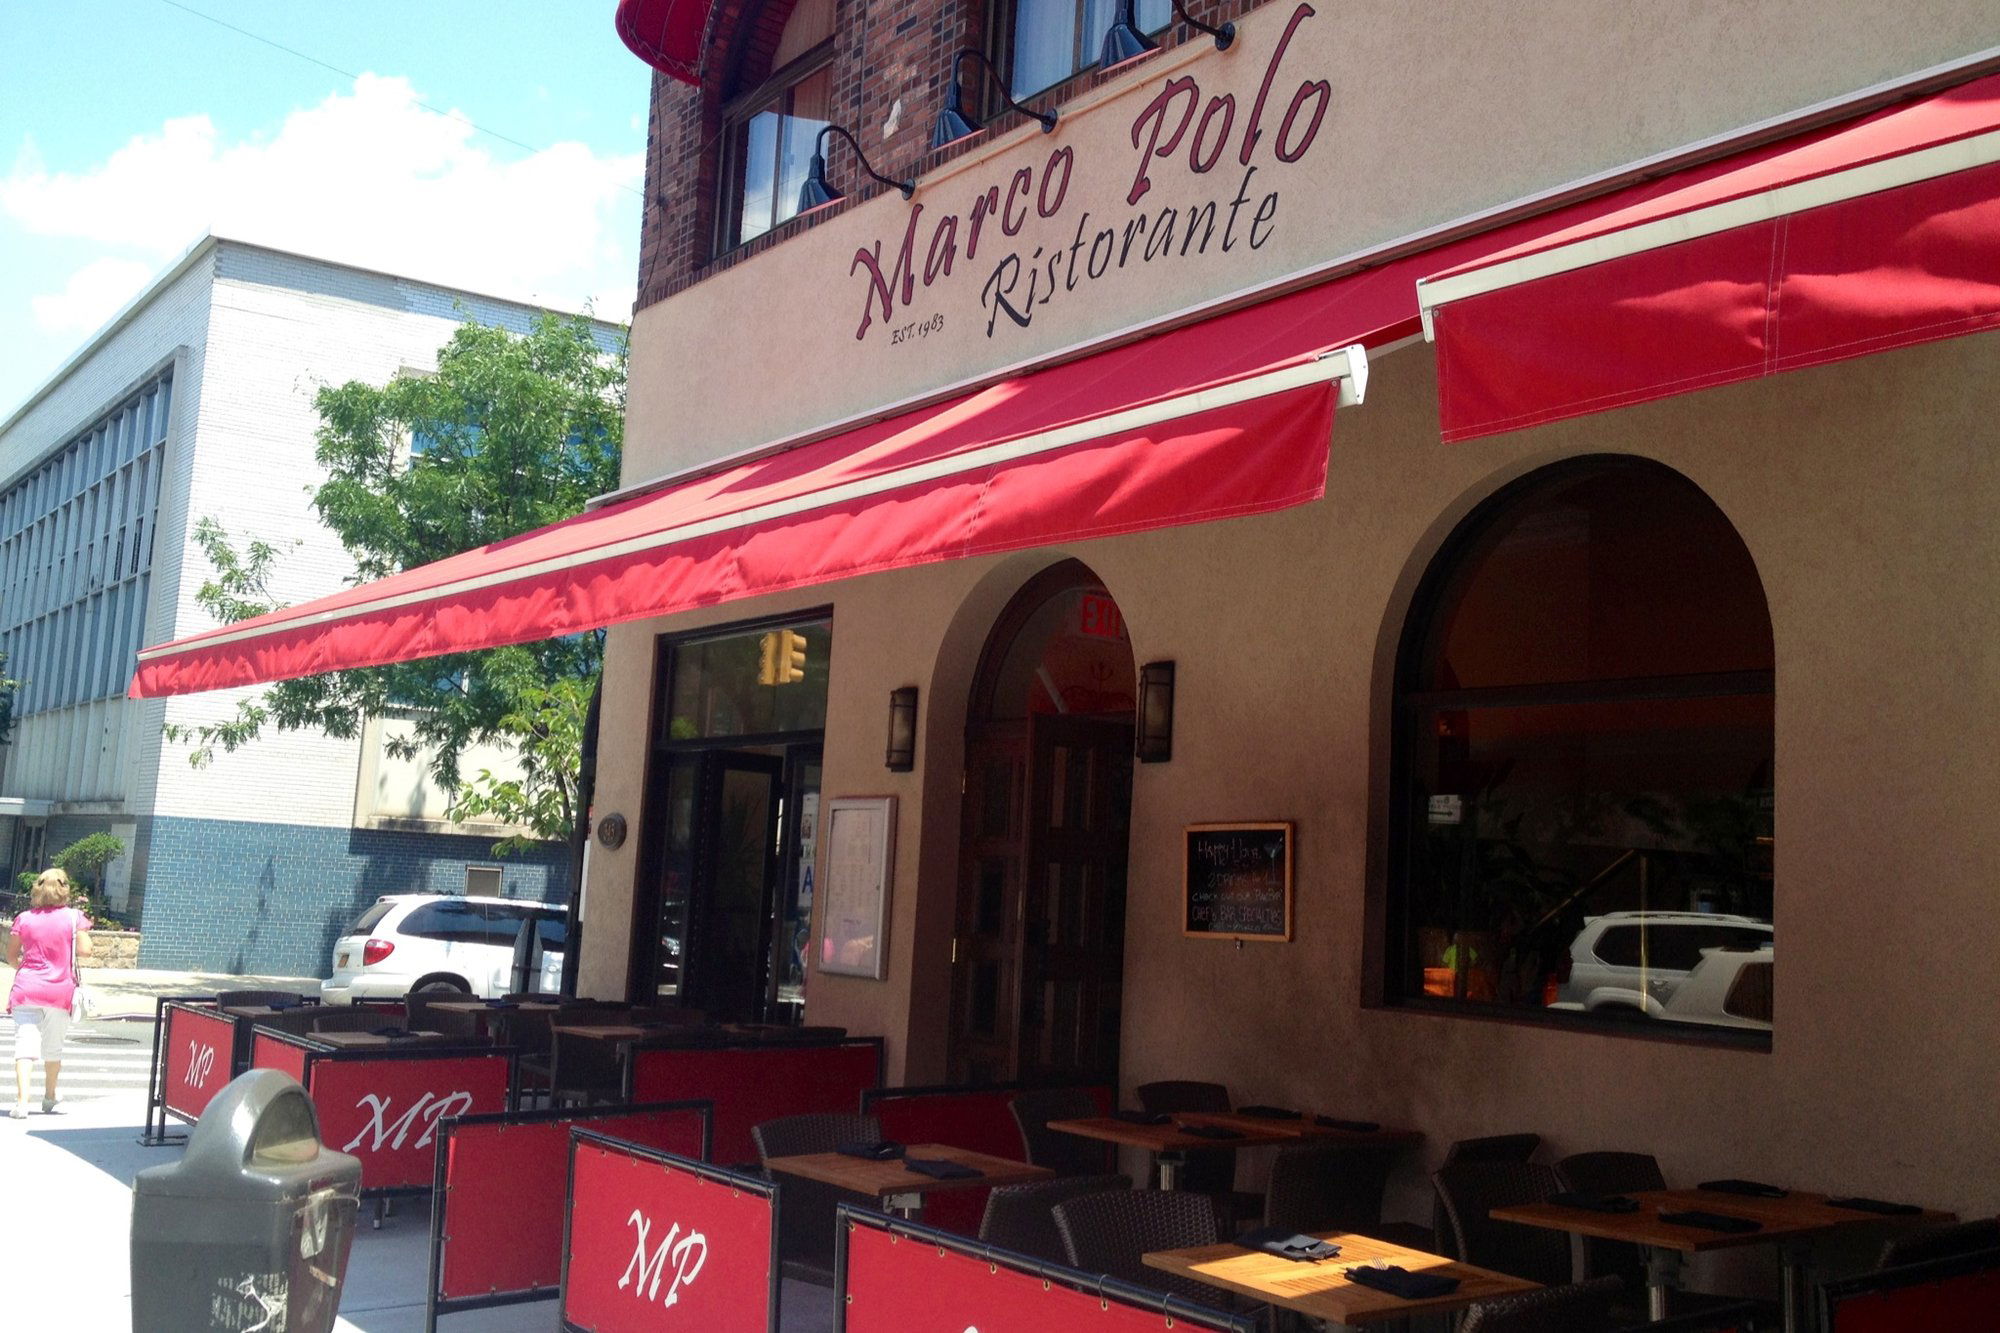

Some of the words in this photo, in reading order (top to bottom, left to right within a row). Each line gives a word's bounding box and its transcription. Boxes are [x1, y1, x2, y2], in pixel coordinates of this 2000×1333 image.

[850, 144, 1073, 341] Marco
[1127, 4, 1332, 206] Polo
[981, 166, 1279, 338] Ristorante
[891, 321, 916, 345] EST.
[918, 313, 944, 338] 1983
[184, 1040, 214, 1089] MP
[342, 1091, 473, 1153] MP
[617, 1208, 708, 1309] MP
